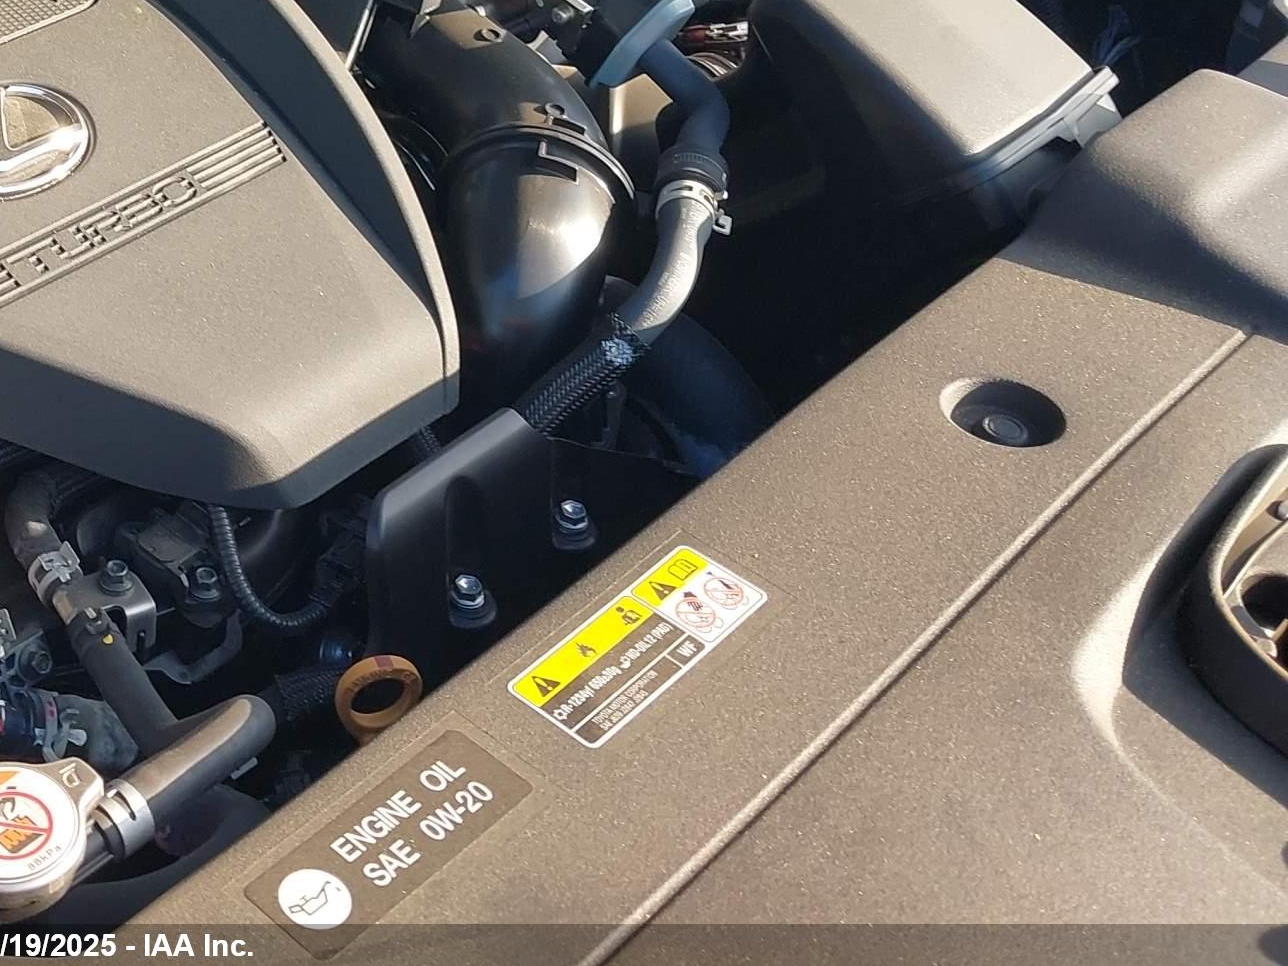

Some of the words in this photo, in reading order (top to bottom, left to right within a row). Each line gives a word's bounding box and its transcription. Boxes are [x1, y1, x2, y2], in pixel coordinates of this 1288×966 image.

[7, 176, 198, 274] TURBO
[591, 707, 614, 725] TOYOTA
[608, 694, 629, 711] MOTOR
[623, 670, 658, 697] CORPORATION
[676, 640, 698, 657] WF
[330, 790, 422, 863] ENGINE
[420, 760, 466, 792] OIL
[363, 839, 422, 887] SAE
[420, 781, 494, 841] 0W-20
